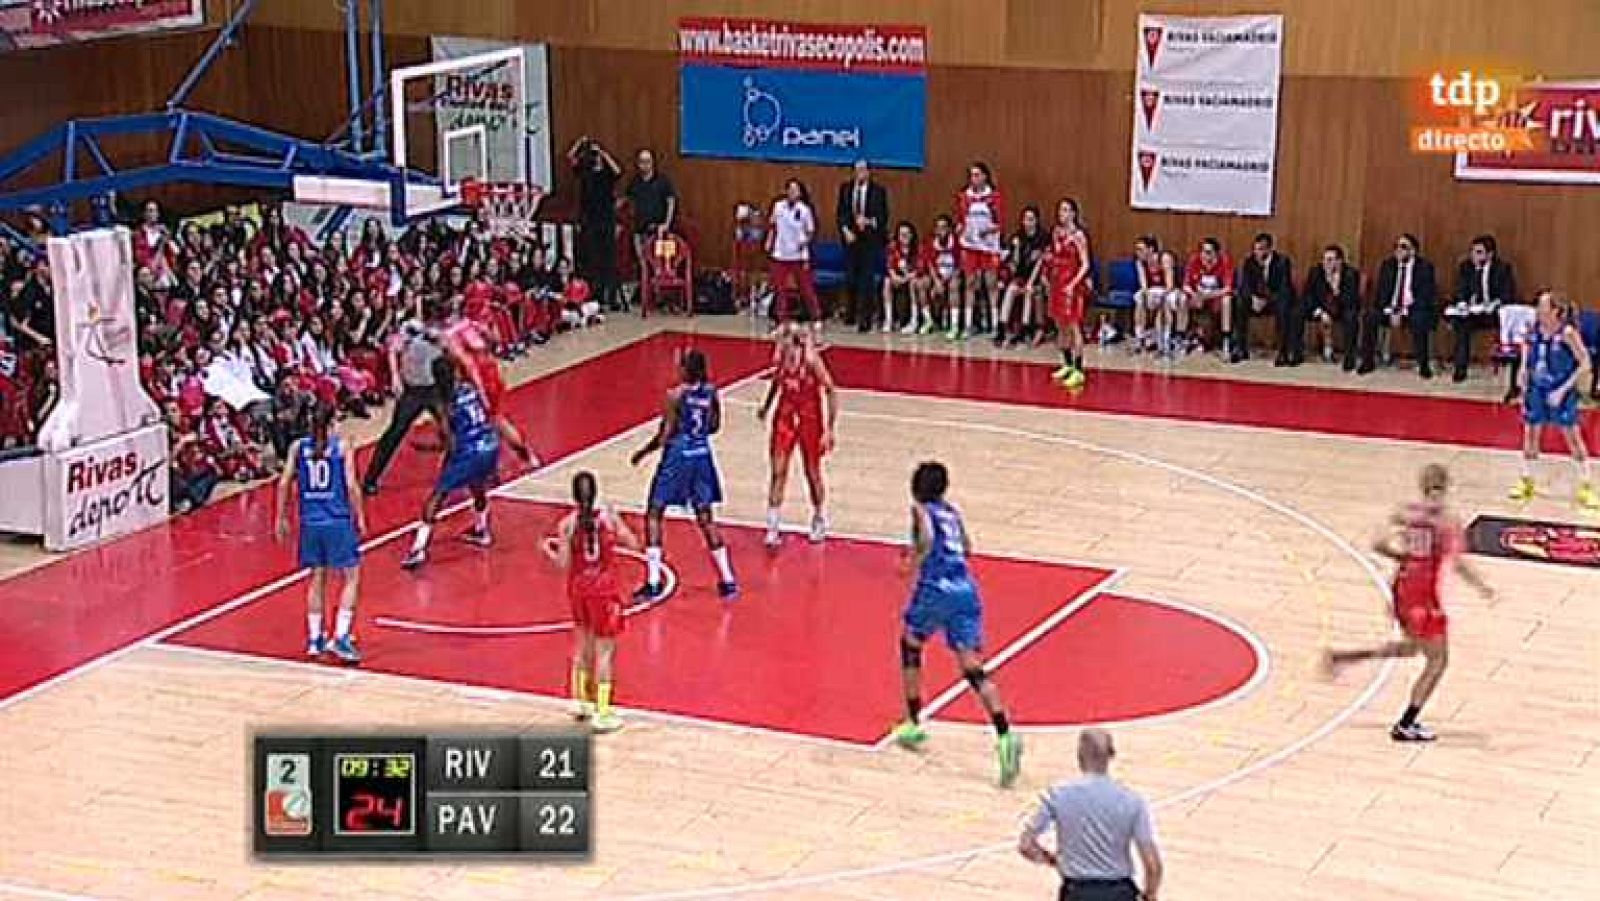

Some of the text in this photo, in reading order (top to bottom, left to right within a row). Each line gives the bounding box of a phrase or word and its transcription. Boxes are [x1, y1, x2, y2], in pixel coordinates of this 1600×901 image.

[446, 74, 513, 101] Rivas
[782, 126, 860, 148] panel
[66, 452, 138, 494] Rivas
[305, 459, 330, 489] 10
